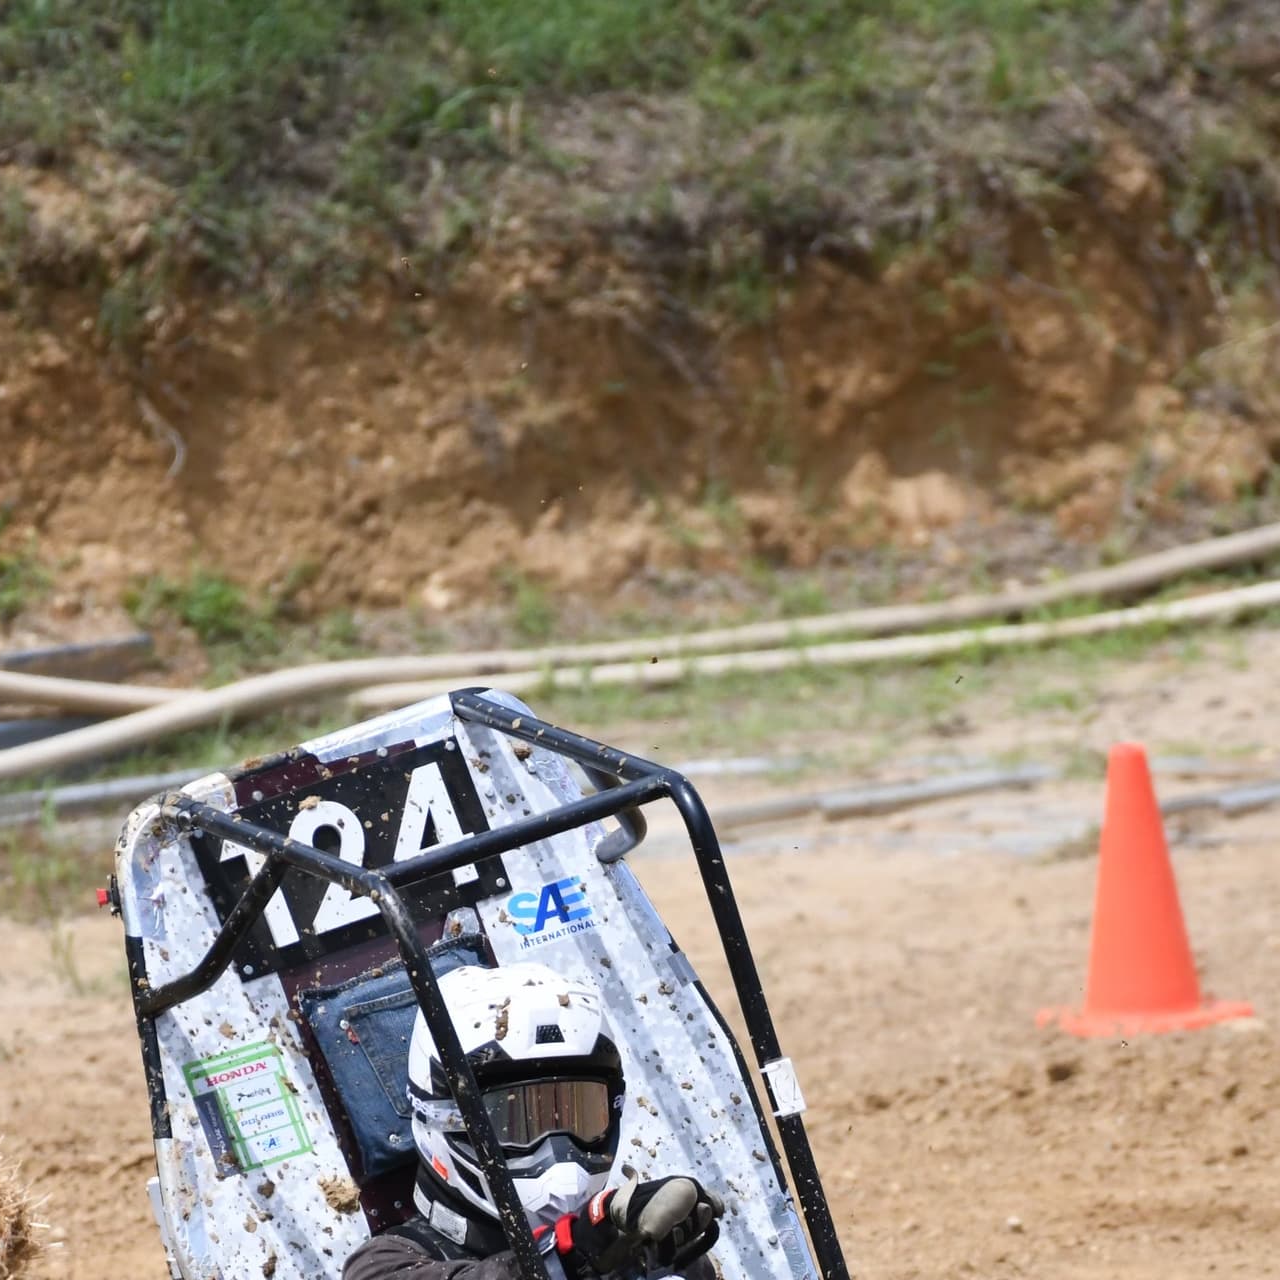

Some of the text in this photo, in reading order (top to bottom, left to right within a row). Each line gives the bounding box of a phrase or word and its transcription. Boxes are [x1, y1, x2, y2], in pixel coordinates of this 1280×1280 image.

[220, 761, 480, 949] 124
[507, 875, 593, 936] SAE
[520, 920, 596, 950] INTERNATIONAL
[205, 1061, 267, 1088] HONDA
